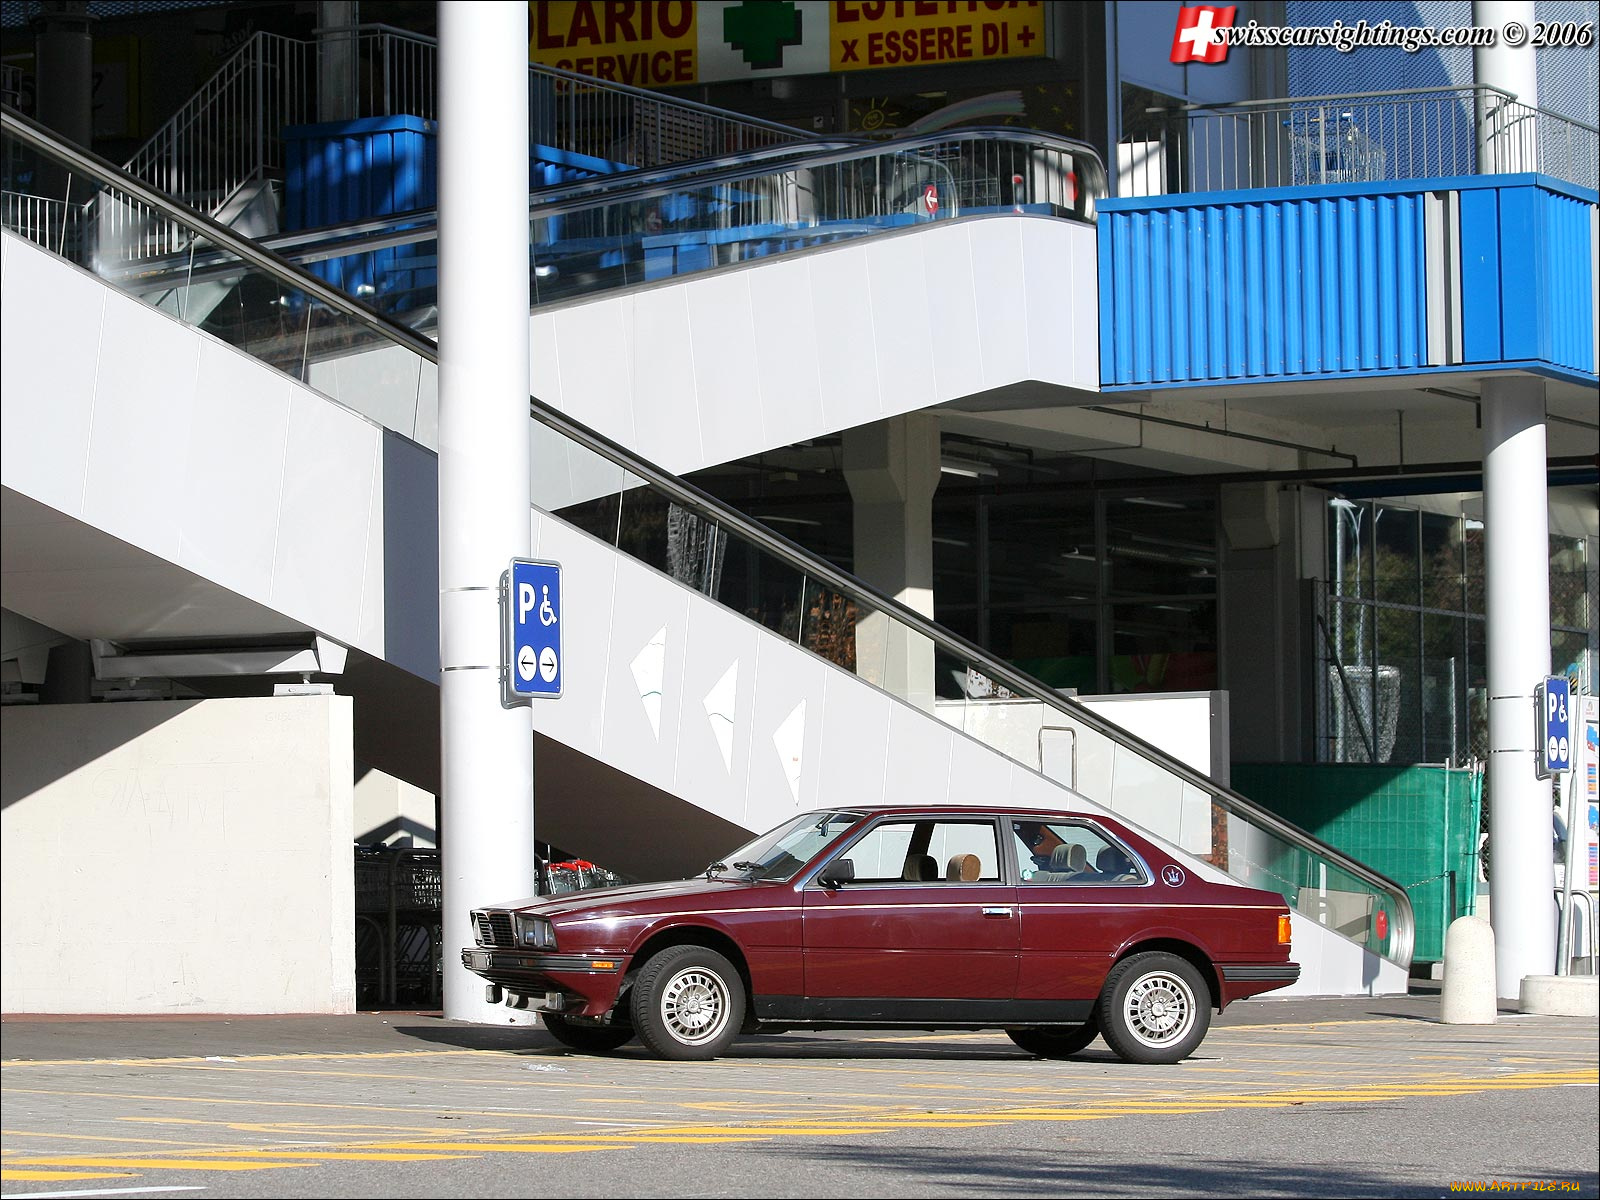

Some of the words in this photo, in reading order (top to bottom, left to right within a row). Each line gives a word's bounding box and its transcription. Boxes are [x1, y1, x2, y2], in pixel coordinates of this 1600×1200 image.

[529, 1, 693, 49] LARIO
[868, 25, 972, 65] ESSERE
[982, 22, 1008, 56] DI
[555, 49, 693, 92] SERVICE
[519, 583, 536, 625] P
[1548, 692, 1558, 722] P
